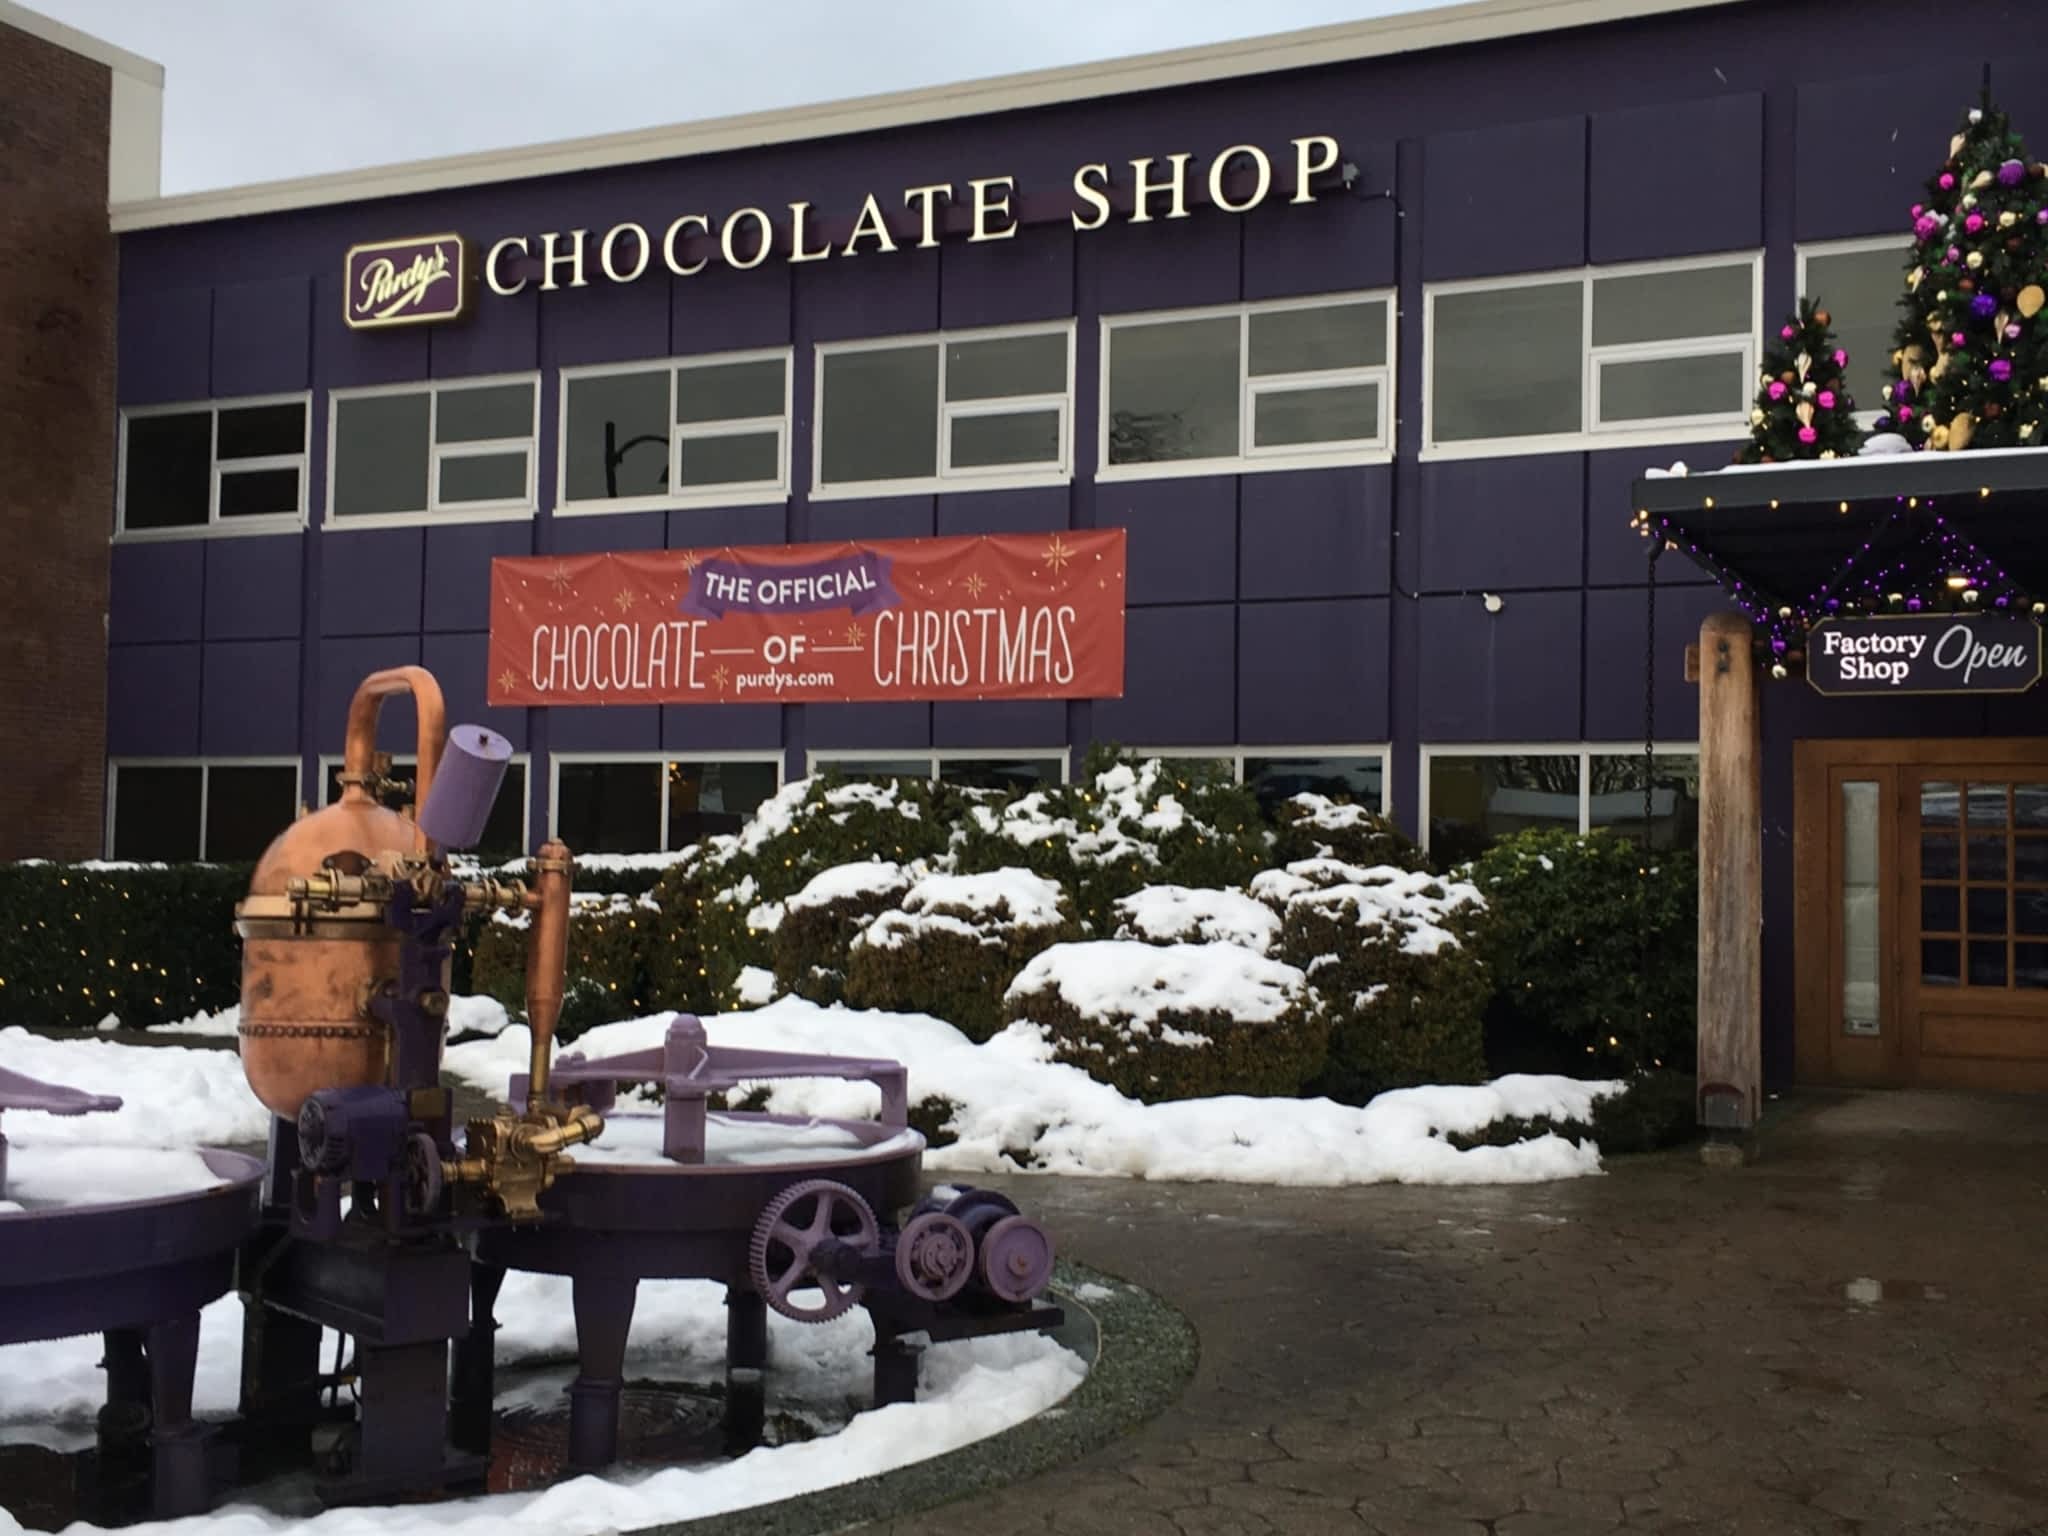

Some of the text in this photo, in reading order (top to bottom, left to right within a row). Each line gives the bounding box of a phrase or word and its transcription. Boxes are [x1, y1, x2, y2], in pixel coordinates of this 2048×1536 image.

[485, 135, 1340, 296] CHOCOLATE SHOP
[355, 244, 452, 319] Purdy's
[705, 566, 876, 604] THE OFFICIAL
[531, 605, 1077, 691] CHOCOLATE OF CHRISTMAS
[1823, 631, 1927, 659] Factory
[1932, 624, 2029, 684] Open
[735, 666, 835, 695] purdys.com
[1839, 656, 1910, 684] Shop
